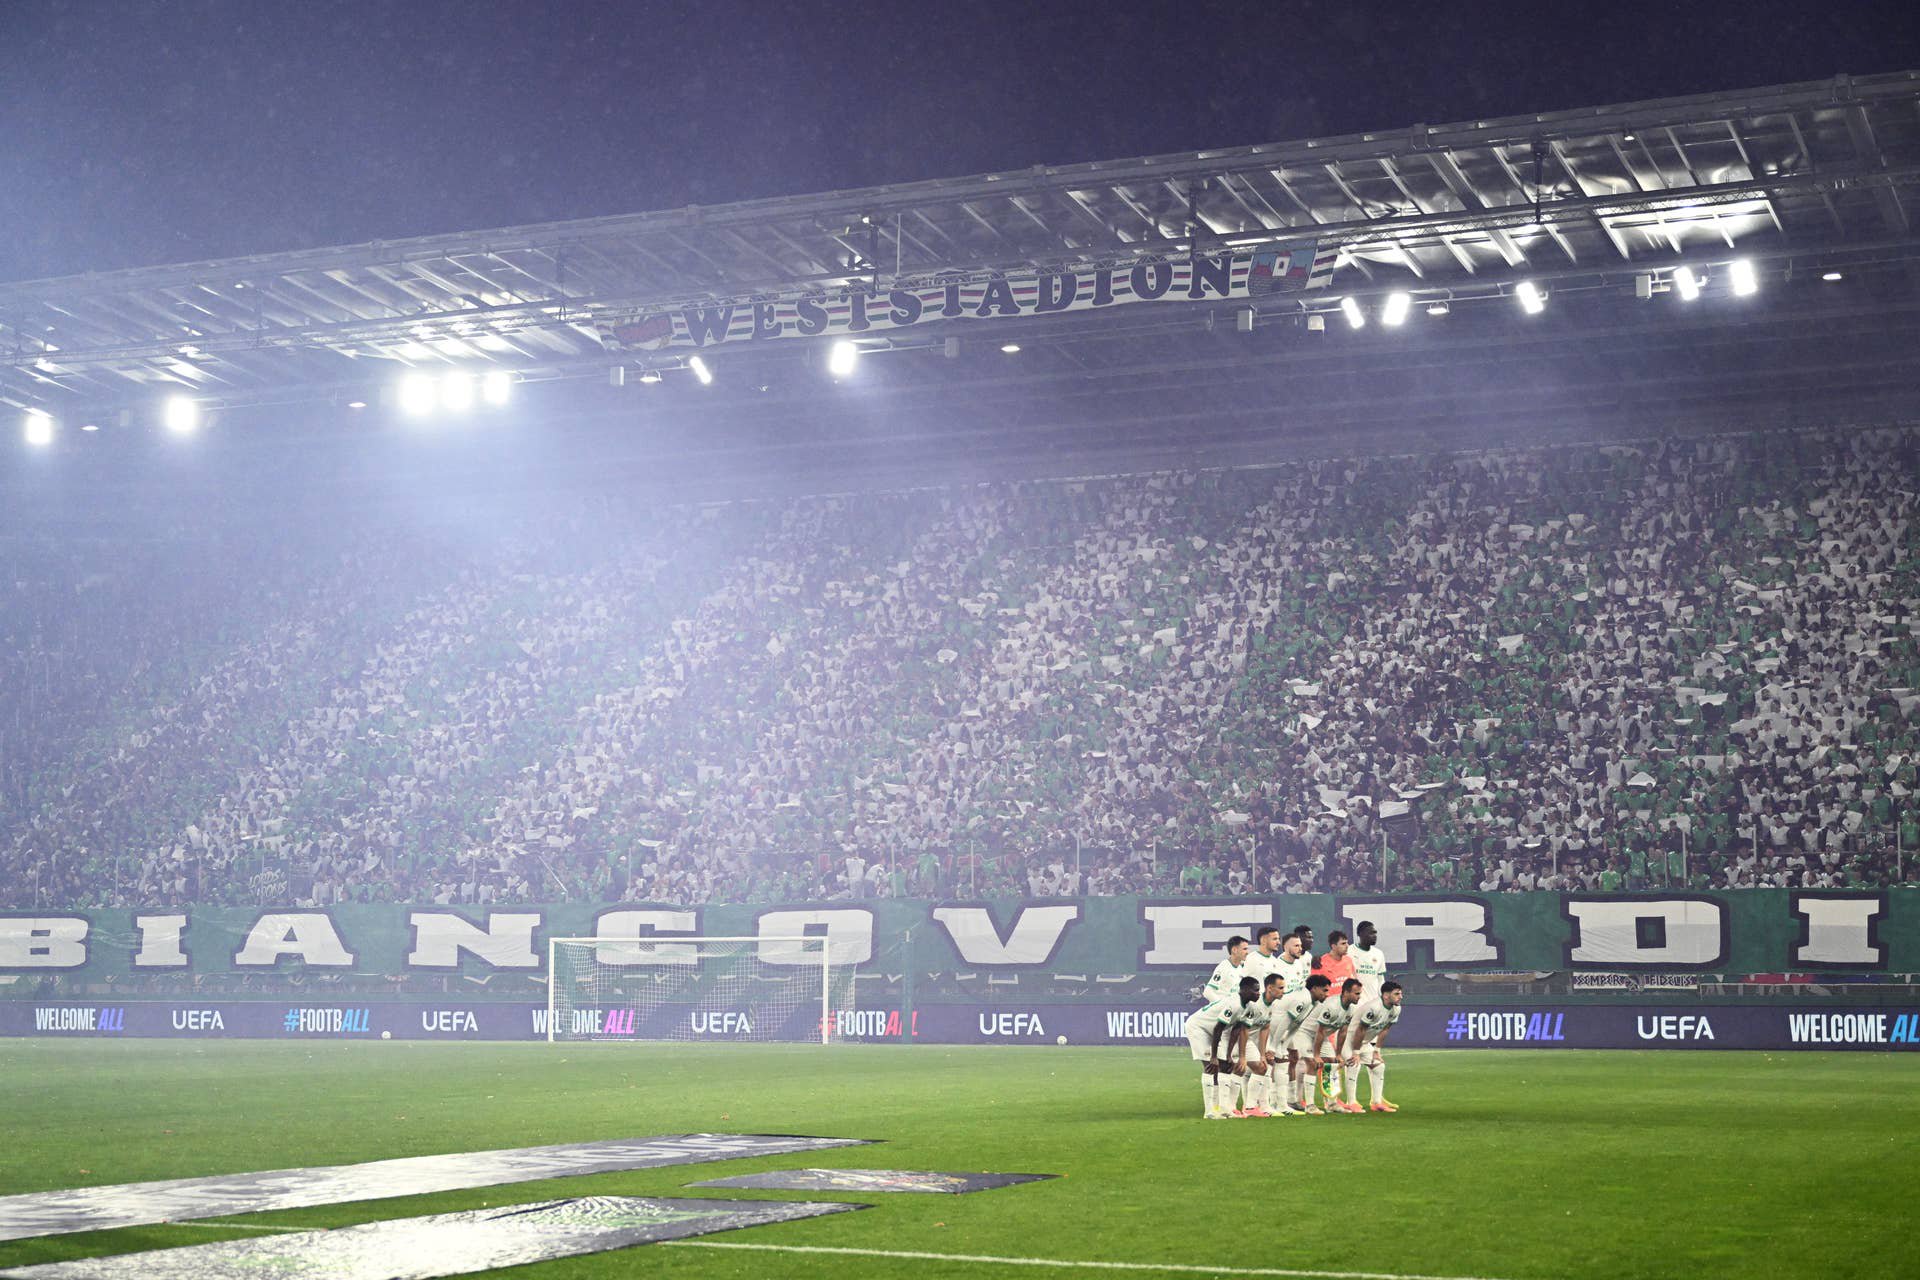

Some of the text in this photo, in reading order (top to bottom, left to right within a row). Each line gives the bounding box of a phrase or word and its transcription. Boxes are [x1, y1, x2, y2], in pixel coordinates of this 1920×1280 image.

[682, 249, 1233, 347] WESTSTADION
[1575, 974, 1694, 987] SEMPER FIDELIS
[35, 1008, 124, 1031] WELCOME ALL
[173, 1010, 224, 1030] UEFA
[284, 1009, 370, 1032] #FOOTBALL
[423, 1011, 478, 1031] UEFA
[532, 1009, 635, 1034] WLOME ALL
[691, 1012, 751, 1033] UEFA
[818, 1010, 918, 1036] #FOOTBAL
[980, 1013, 1044, 1035] UEFA
[1106, 1011, 1189, 1038] WELCOME
[1446, 1013, 1565, 1040] #FOOTBALL
[1637, 1016, 1715, 1039] UEFA
[1789, 1014, 1887, 1042] WELCOME
